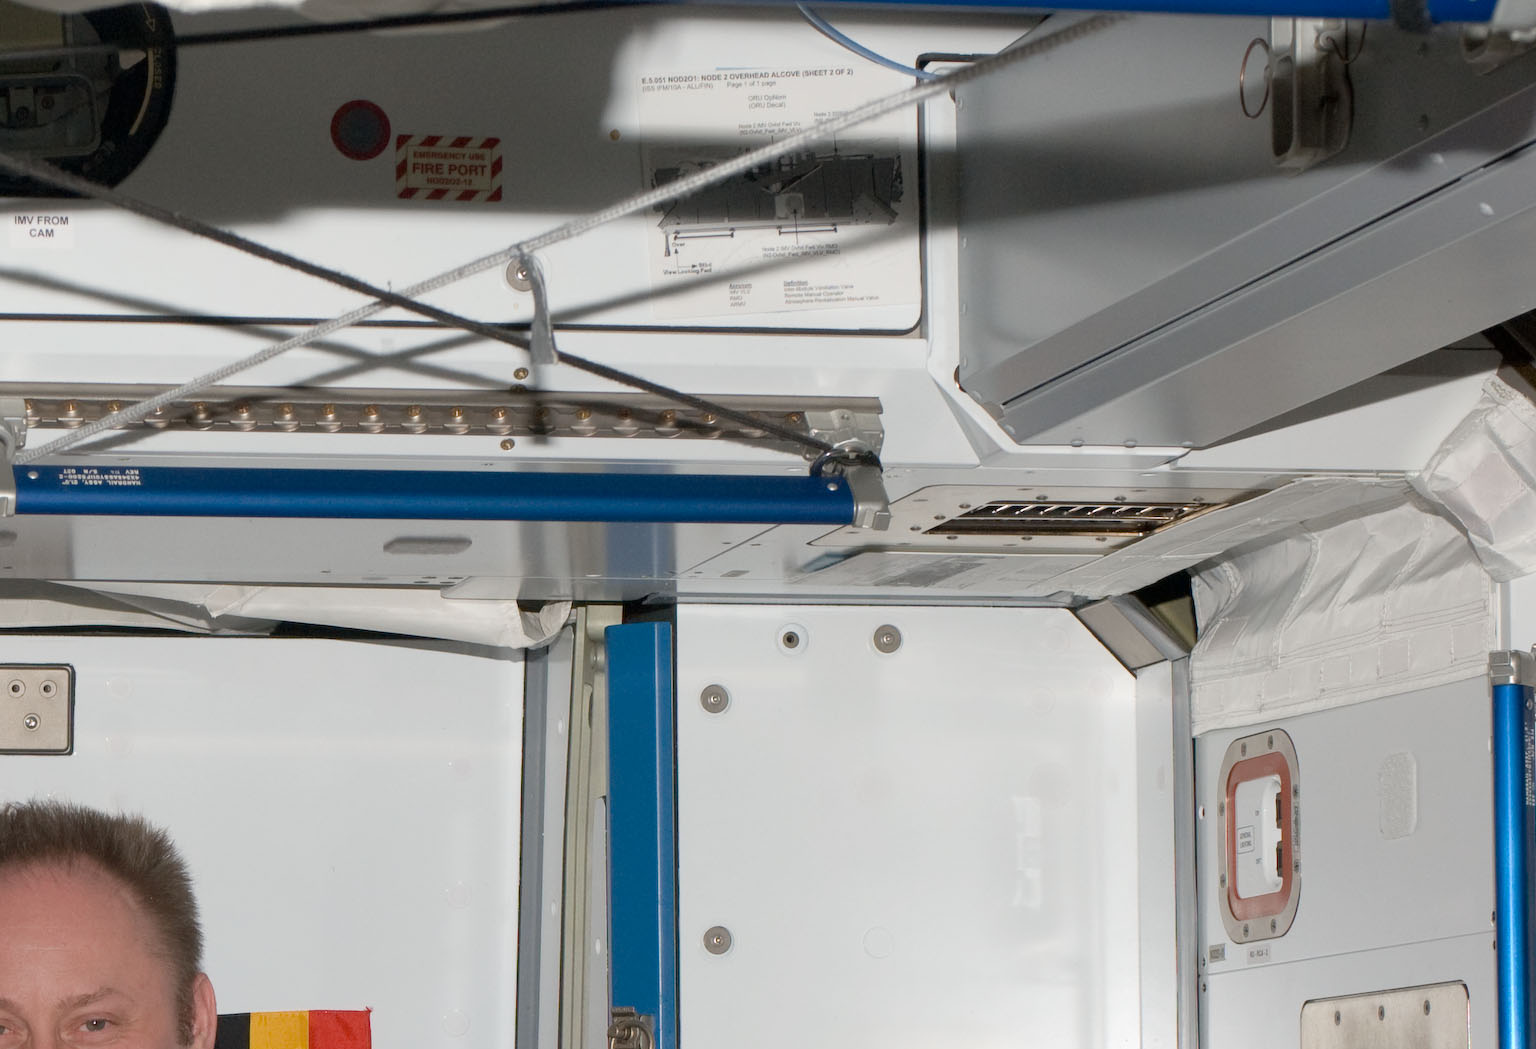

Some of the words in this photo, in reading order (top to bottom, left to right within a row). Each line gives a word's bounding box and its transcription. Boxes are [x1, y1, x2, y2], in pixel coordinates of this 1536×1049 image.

[729, 71, 770, 80] OVERHEAD
[771, 70, 801, 78] ALCOVE
[835, 68, 845, 76] OF
[413, 151, 466, 160] EMERGENCY
[469, 152, 486, 161] USE
[412, 162, 444, 174] FIRE
[448, 164, 487, 176] PORT
[14, 215, 34, 225] IMV
[37, 215, 69, 225] FROM
[29, 228, 54, 238] CAM
